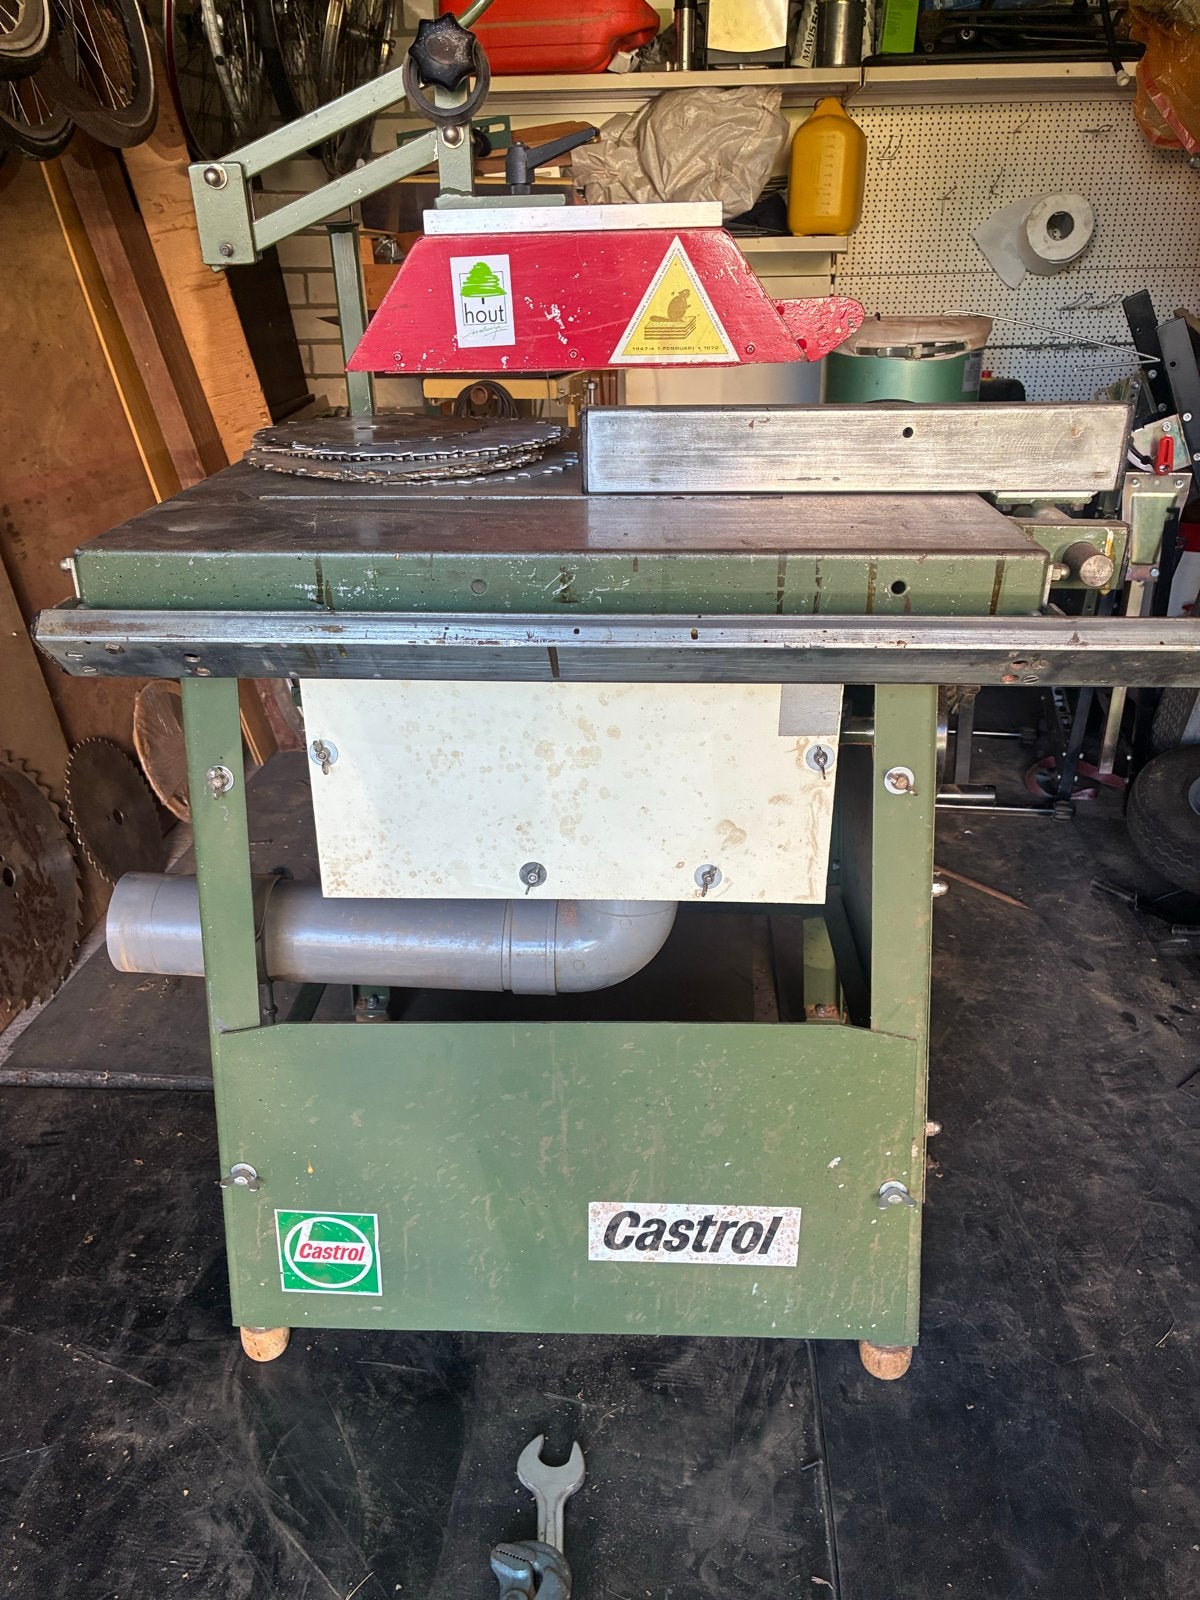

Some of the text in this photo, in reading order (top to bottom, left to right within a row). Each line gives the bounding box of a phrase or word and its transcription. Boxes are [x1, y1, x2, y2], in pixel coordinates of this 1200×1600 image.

[802, 24, 817, 62] MAVIS
[464, 303, 504, 323] hout
[603, 1210, 783, 1255] Castrol
[299, 1243, 366, 1261] Castrol
